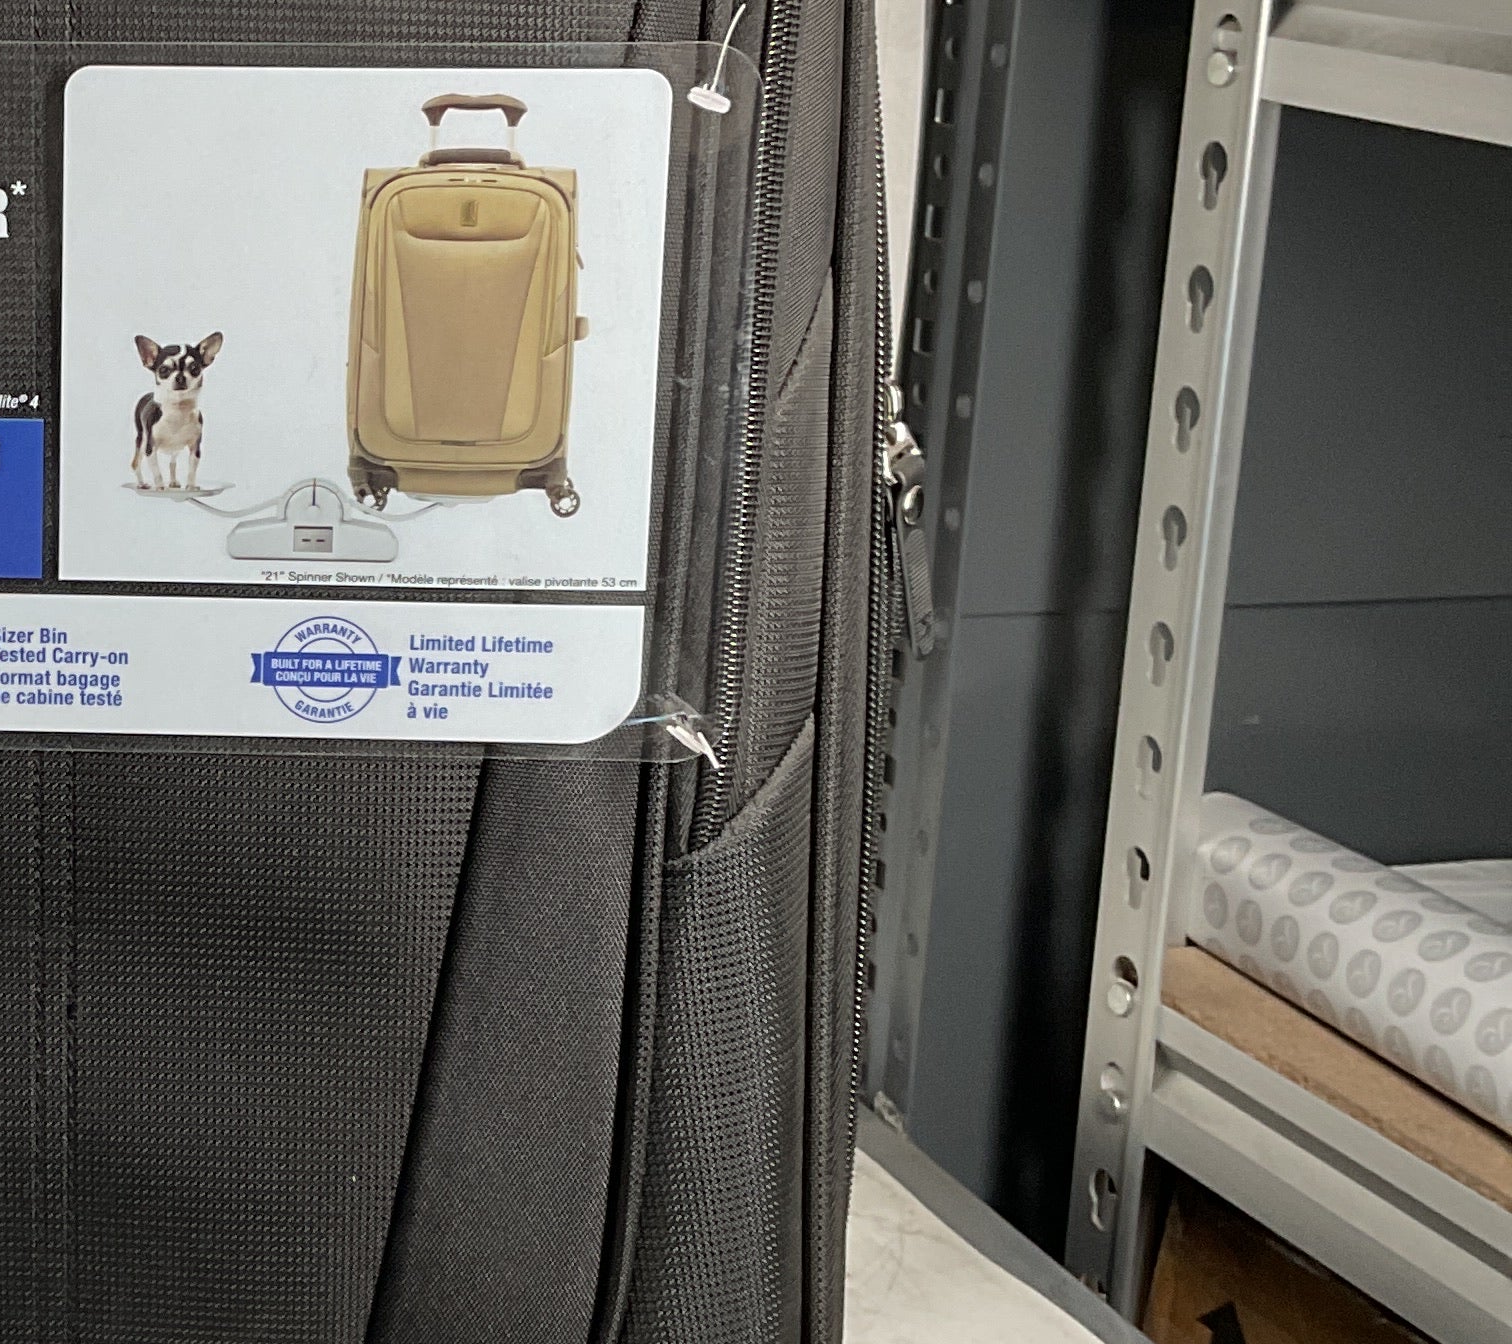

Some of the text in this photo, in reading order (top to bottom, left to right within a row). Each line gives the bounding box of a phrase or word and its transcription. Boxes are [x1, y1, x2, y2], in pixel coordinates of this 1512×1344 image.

[30, 396, 39, 408] 4
[288, 571, 332, 583] Spinner
[336, 572, 375, 583] Shown
[508, 577, 541, 587] valise
[544, 577, 598, 589] pivotante
[602, 578, 616, 588] 53
[619, 580, 638, 588] cm
[39, 628, 68, 644] Bin
[294, 623, 362, 645] WARRANTY
[410, 635, 553, 653] Limited Lifetime
[52, 647, 129, 668] Carry-on
[271, 659, 382, 671] BUILT FOR A LIFETIME
[409, 657, 489, 678] Warranty
[57, 670, 121, 690] bagage
[275, 672, 376, 683] CONÇU POUR LA VIE
[16, 689, 74, 706] cabine
[80, 690, 123, 706] testé
[408, 680, 553, 698] Garantie Limitée
[294, 700, 354, 719] GARANTIE
[407, 702, 448, 719] à vie
